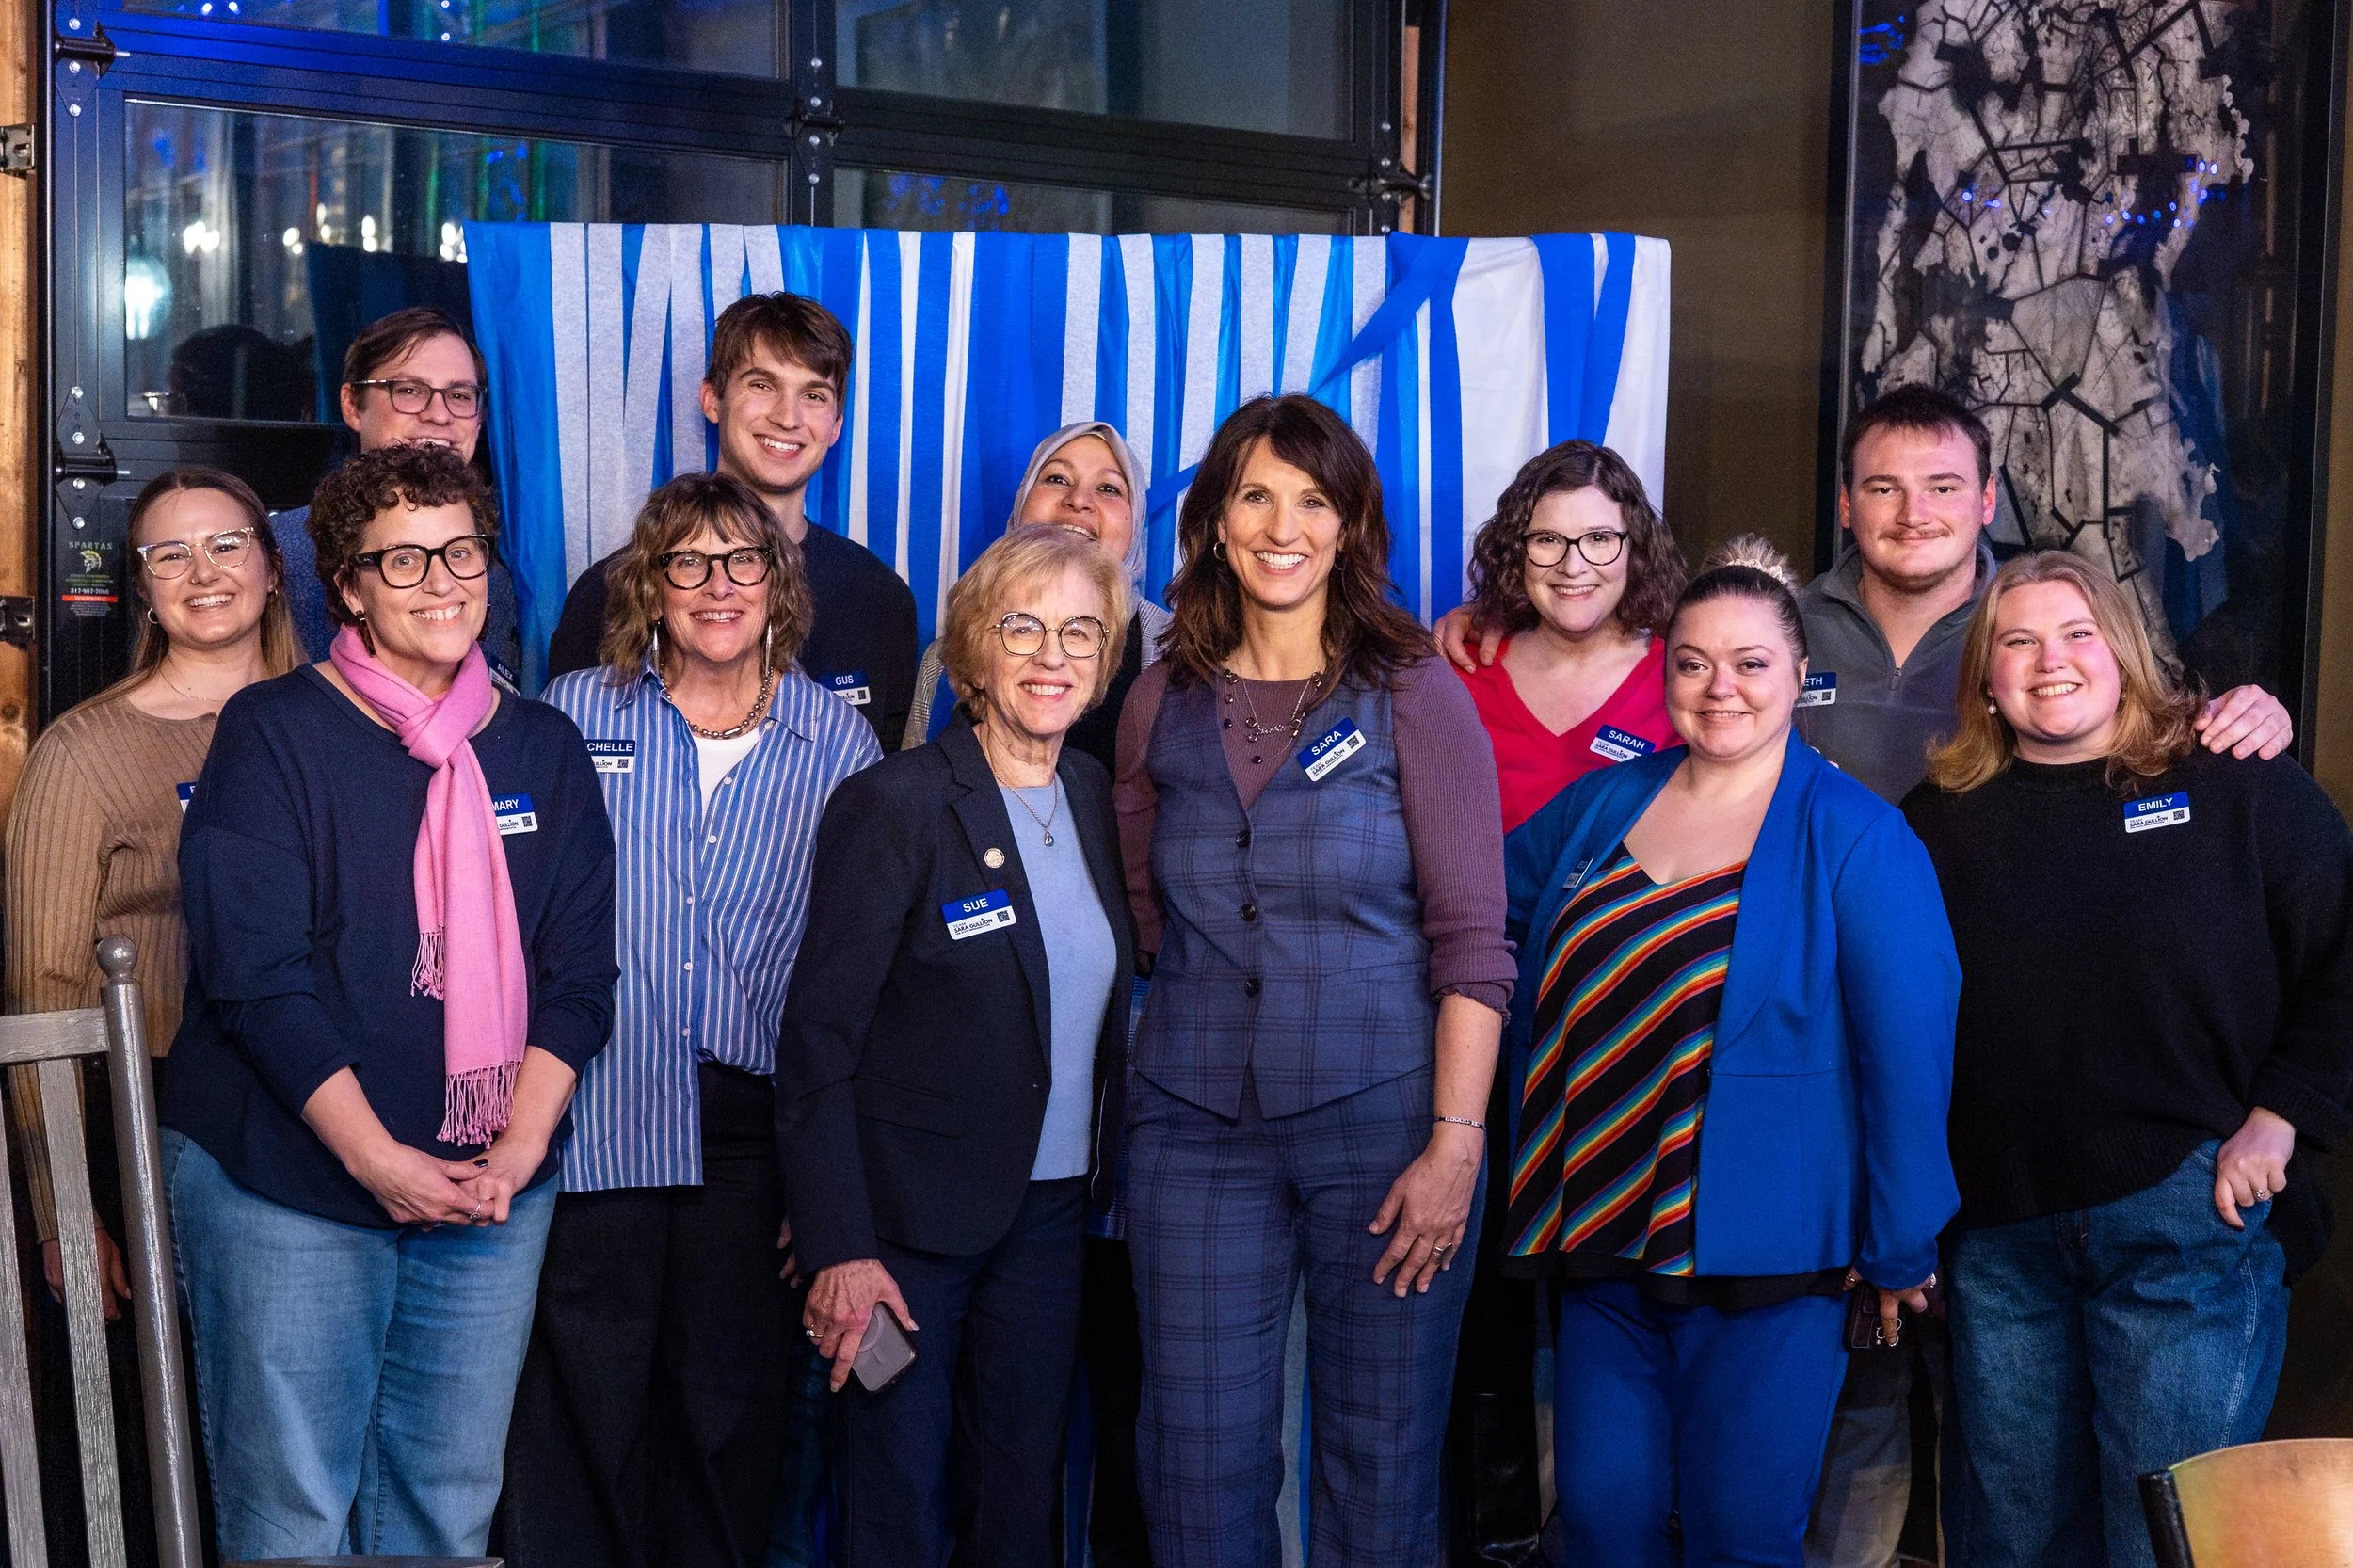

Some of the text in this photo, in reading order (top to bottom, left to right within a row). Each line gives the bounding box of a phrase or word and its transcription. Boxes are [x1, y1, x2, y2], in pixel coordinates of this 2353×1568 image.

[69, 541, 112, 550] SPARTAN
[835, 674, 854, 686] GUS
[1804, 677, 1823, 687] ETH
[1311, 731, 1342, 755] SARA
[1608, 730, 1646, 750] SARAH
[587, 742, 634, 752] CHELLE
[492, 799, 518, 811] MARY
[2138, 797, 2173, 812] EMILY
[963, 898, 989, 912] SUE
[969, 919, 993, 928] GULLION
